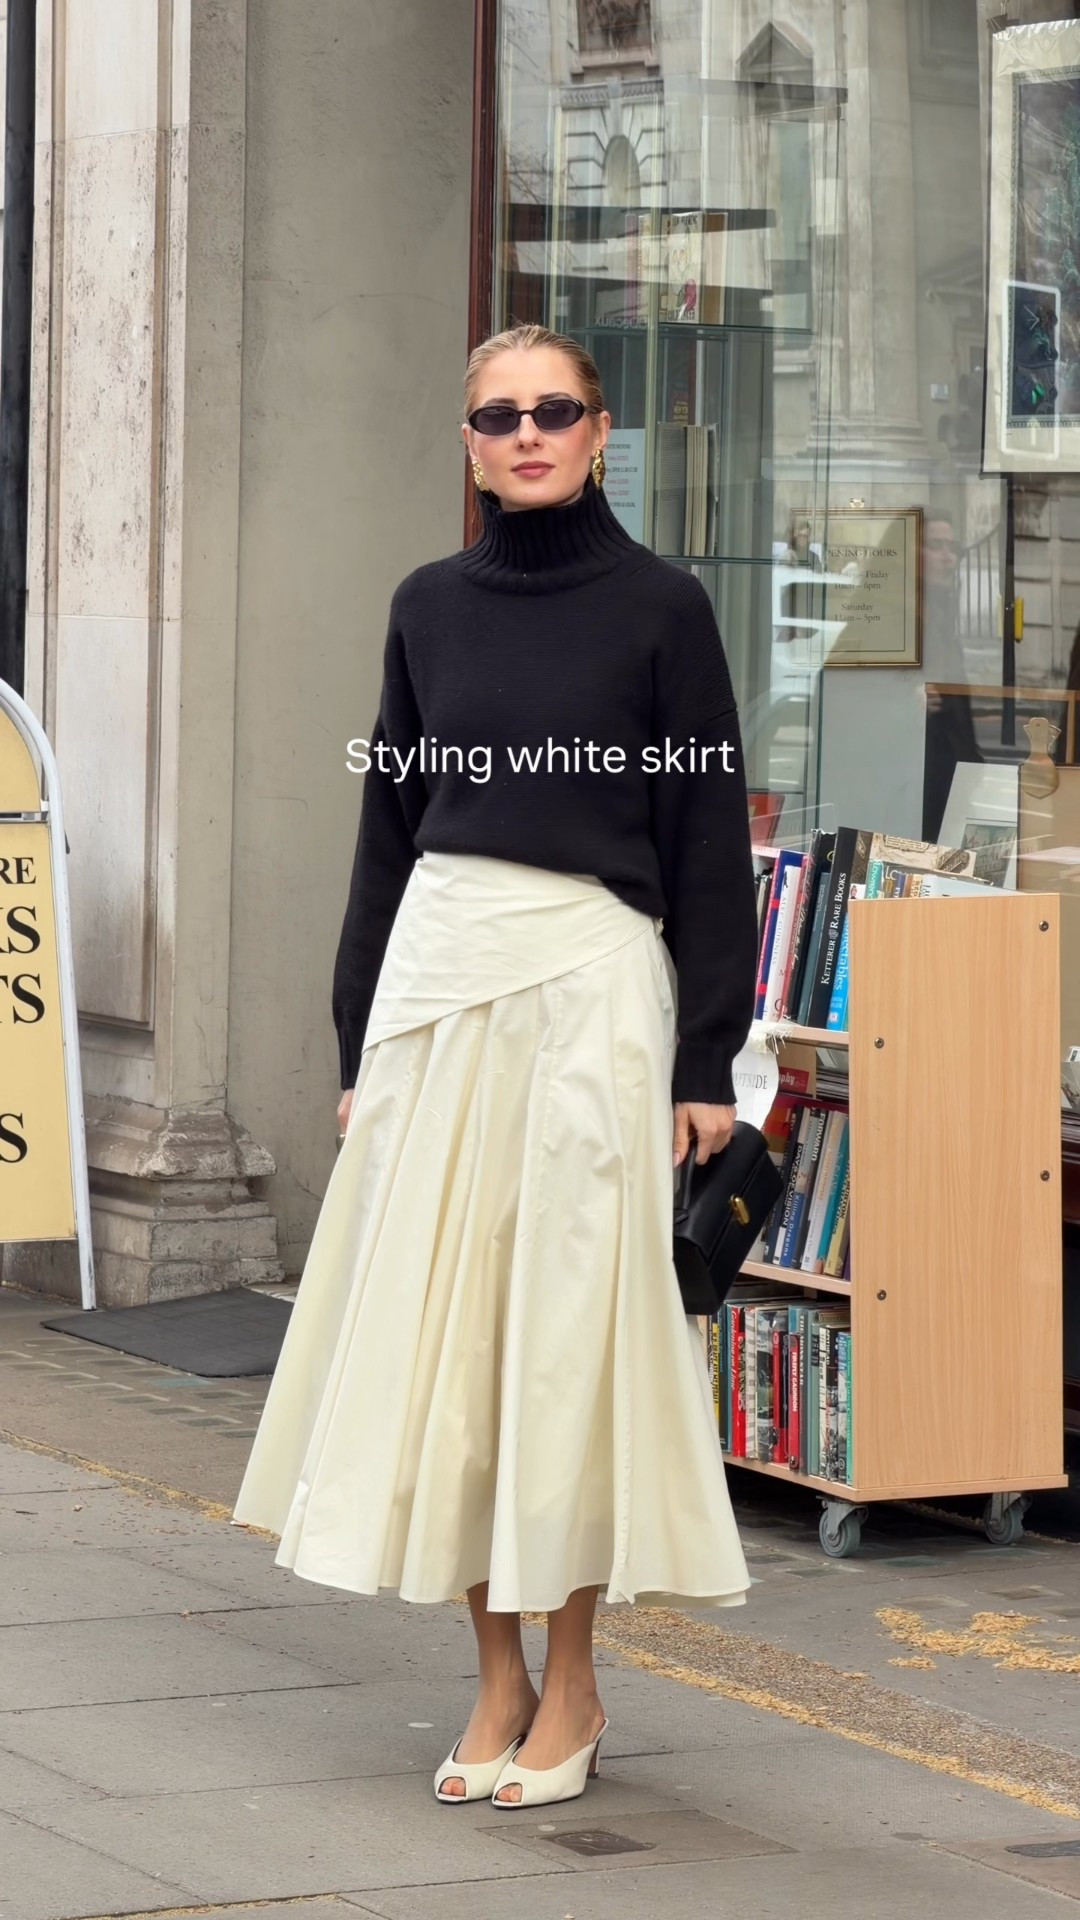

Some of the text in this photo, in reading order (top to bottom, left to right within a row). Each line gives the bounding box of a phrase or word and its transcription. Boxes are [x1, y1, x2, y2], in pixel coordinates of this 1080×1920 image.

[863, 582, 881, 591] 6pm
[841, 602, 873, 613] Saturday
[864, 613, 881, 623] 5pm
[834, 872, 847, 902] BOOKS
[830, 904, 842, 929] RARE
[772, 920, 782, 965] GUINNESS
[820, 940, 836, 985] KETTERER
[732, 1071, 768, 1090] UTSIDE
[811, 1112, 826, 1161] FORWARD
[791, 1145, 803, 1172] DAYS
[789, 1174, 798, 1188] OF
[782, 1190, 794, 1226] VISION
[790, 1194, 800, 1221] Killing
[783, 1223, 794, 1257] Dragons
